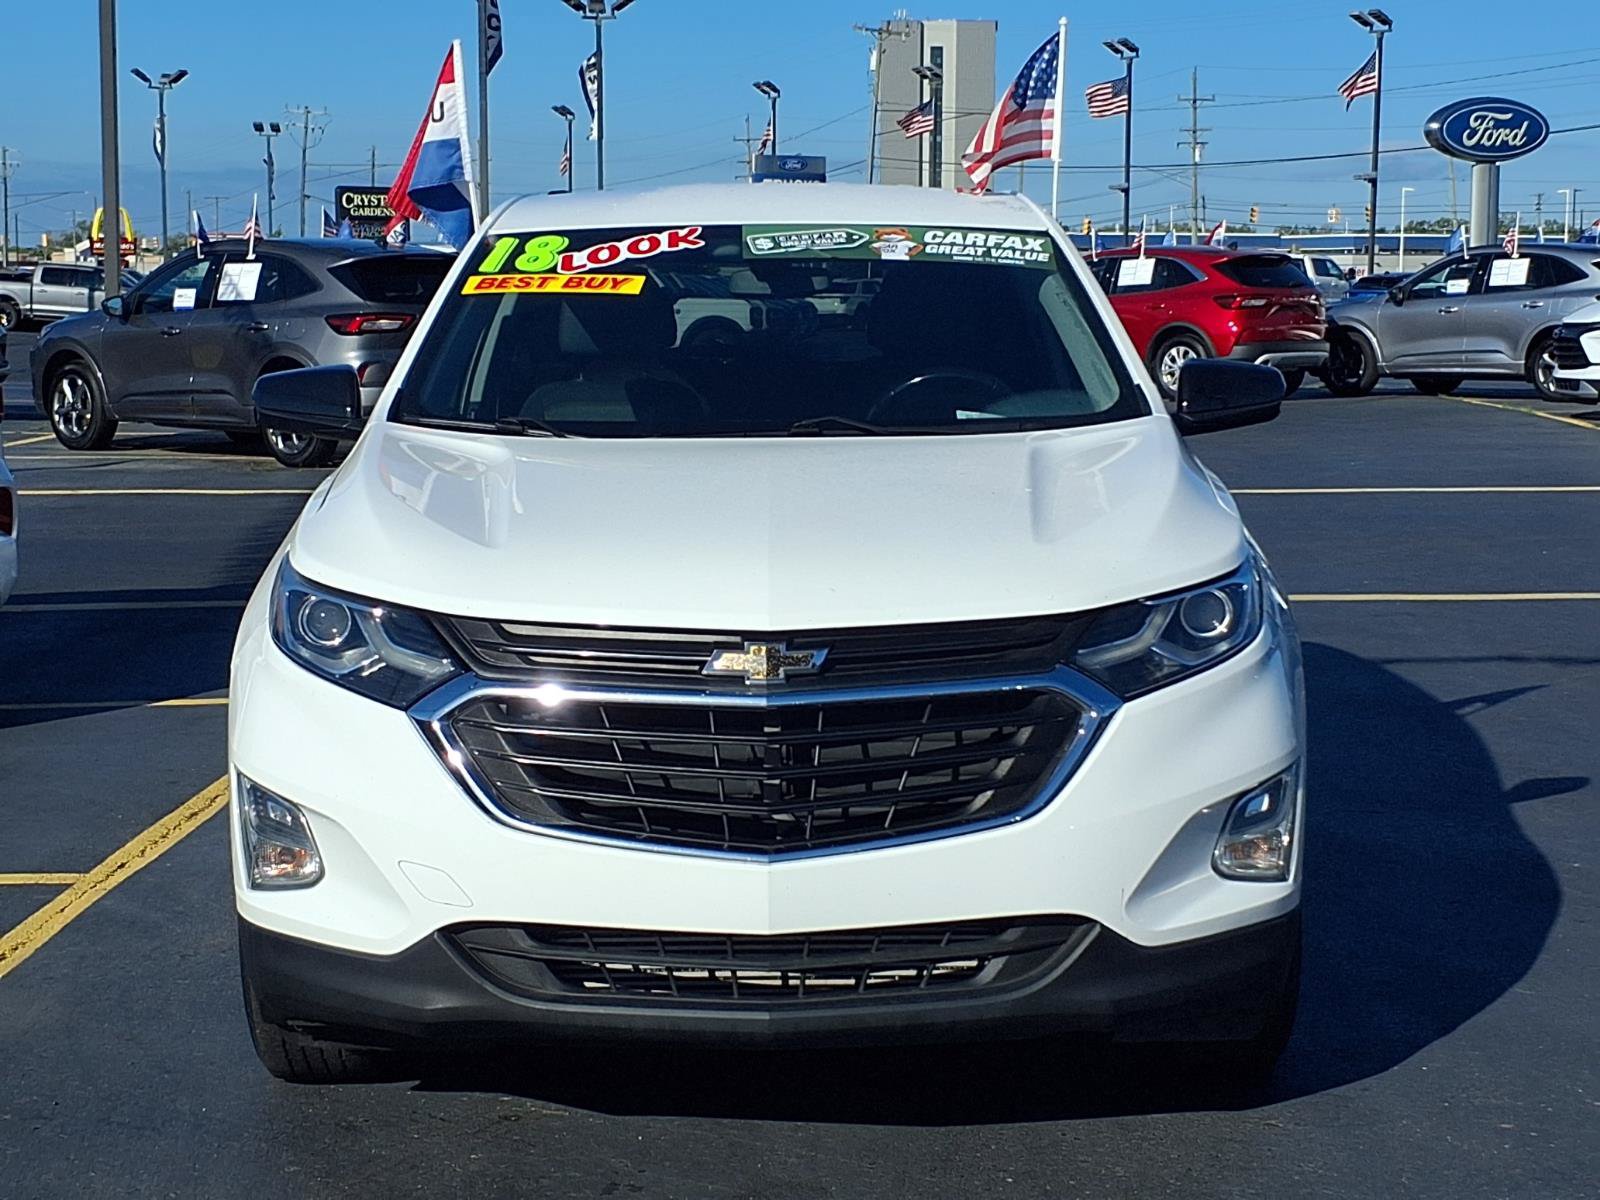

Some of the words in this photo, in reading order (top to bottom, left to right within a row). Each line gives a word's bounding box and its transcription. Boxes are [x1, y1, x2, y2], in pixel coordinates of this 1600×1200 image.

[1462, 111, 1529, 147] Ford
[342, 192, 389, 209] CRYST
[350, 207, 396, 217] GARDENS
[558, 226, 703, 274] LOOK
[923, 230, 1046, 251] CARFAX
[478, 235, 569, 273] 18
[925, 244, 987, 256] GREAT
[990, 248, 1050, 262] VALUE
[474, 276, 552, 291] BEST
[561, 276, 637, 291] BUY
